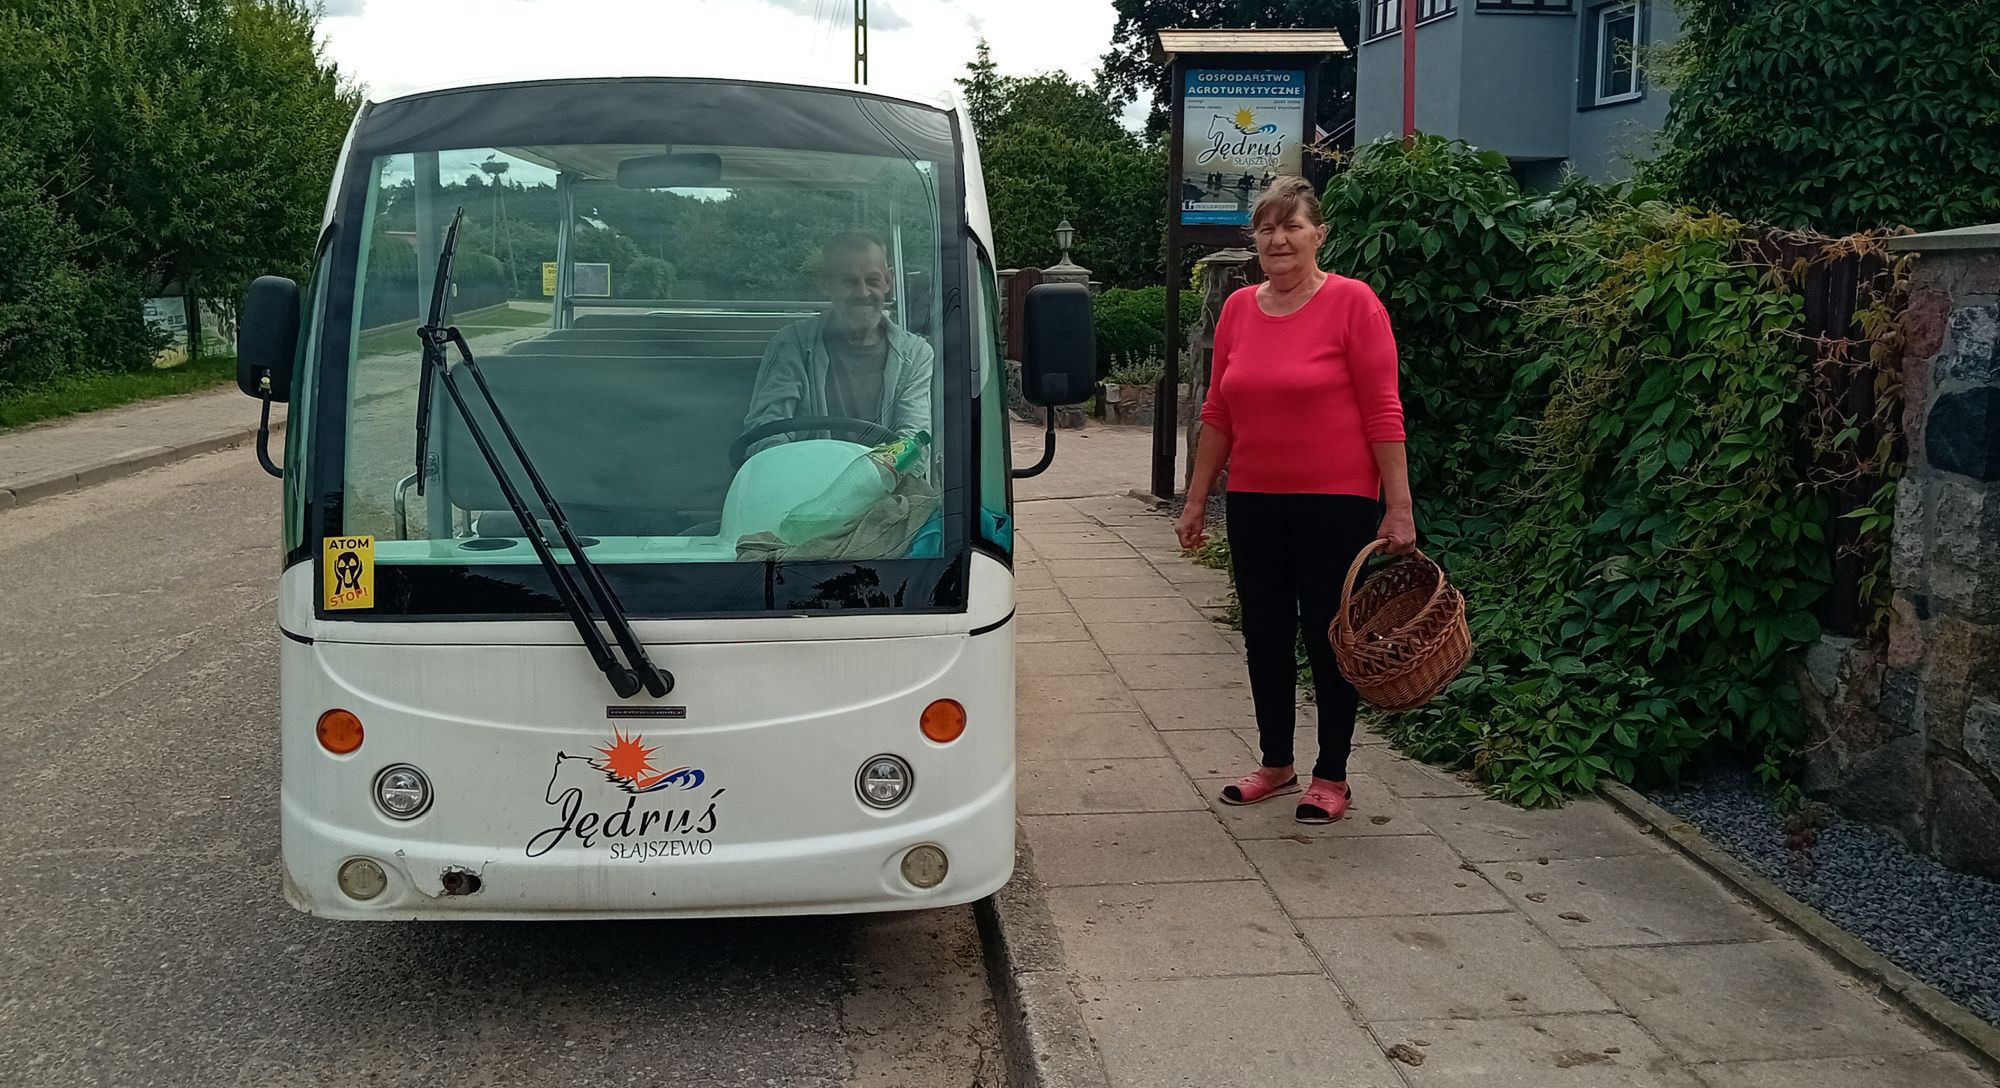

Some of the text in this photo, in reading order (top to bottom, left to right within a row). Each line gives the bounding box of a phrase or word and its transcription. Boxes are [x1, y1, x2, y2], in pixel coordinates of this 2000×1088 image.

[1197, 73, 1291, 82] GOSPODARSTWO
[1187, 86, 1301, 95] AGROTURYSTYCZNE
[1197, 131, 1286, 165] Jędruś
[328, 538, 369, 550] ATOM
[329, 587, 368, 607] STOP!
[525, 788, 726, 858] Jędruś
[609, 838, 713, 863] SŁAJSZEWO
